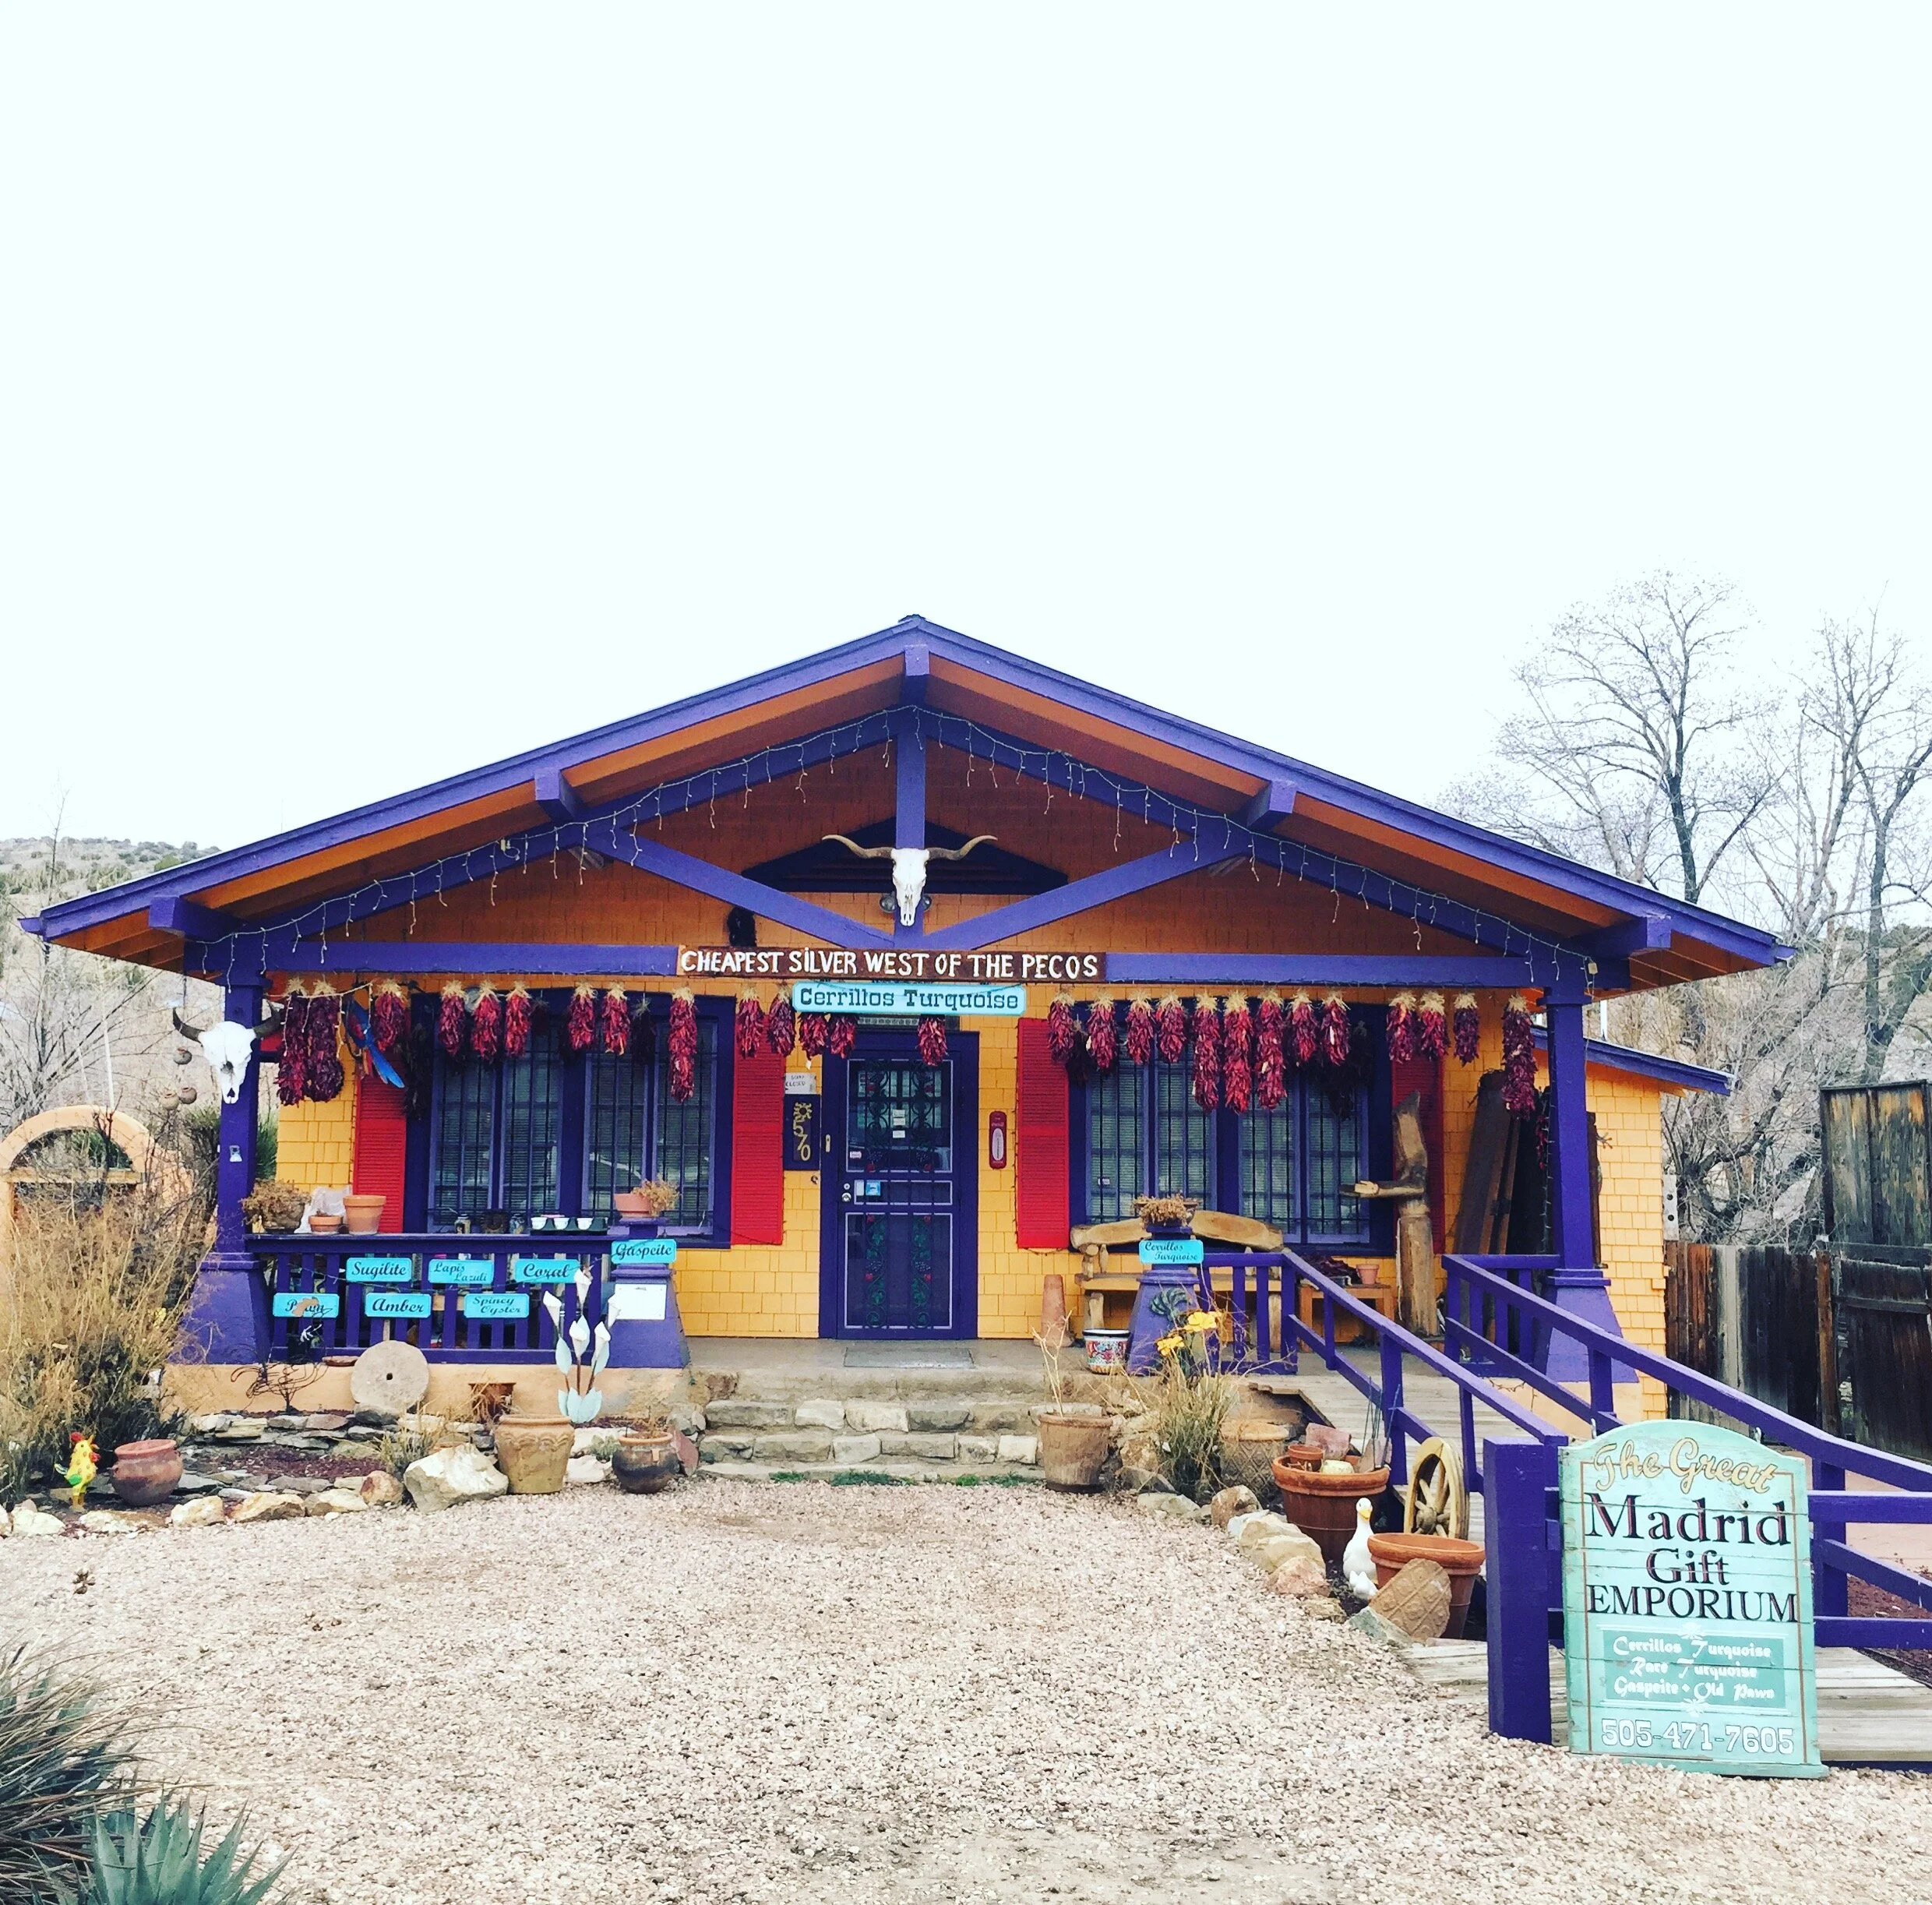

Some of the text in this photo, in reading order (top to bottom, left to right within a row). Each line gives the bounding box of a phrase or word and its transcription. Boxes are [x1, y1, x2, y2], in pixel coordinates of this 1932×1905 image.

[680, 950, 784, 973] CHEAPEST
[863, 951, 930, 977] WEST
[935, 953, 961, 978] OF
[967, 953, 1014, 979] THE
[1021, 953, 1098, 979] PECOS
[800, 987, 1019, 1011] Cerrillos Turquoise
[615, 1240, 672, 1261] Gaspeite
[1144, 1240, 1184, 1251] Cerrillos
[1154, 1251, 1199, 1263] Turquoise
[351, 1261, 407, 1280] Sugilite
[433, 1261, 466, 1274] Lapis
[453, 1272, 488, 1282] Lazuli
[523, 1262, 570, 1280] Coral
[372, 1297, 425, 1313] Amber
[480, 1305, 522, 1316] Oyster
[1593, 1436, 1779, 1494] The Great
[1584, 1492, 1792, 1546] Madrid
[1646, 1547, 1729, 1586] Gift
[1585, 1584, 1798, 1623] EMPORIUM
[1613, 1635, 1772, 1659] Cerrillos Turquoise
[1629, 1656, 1758, 1681] Rare Turquoise
[1613, 1675, 1775, 1702] Gaspeite Old Pawn
[1601, 1718, 1795, 1755] 505-471-7605
